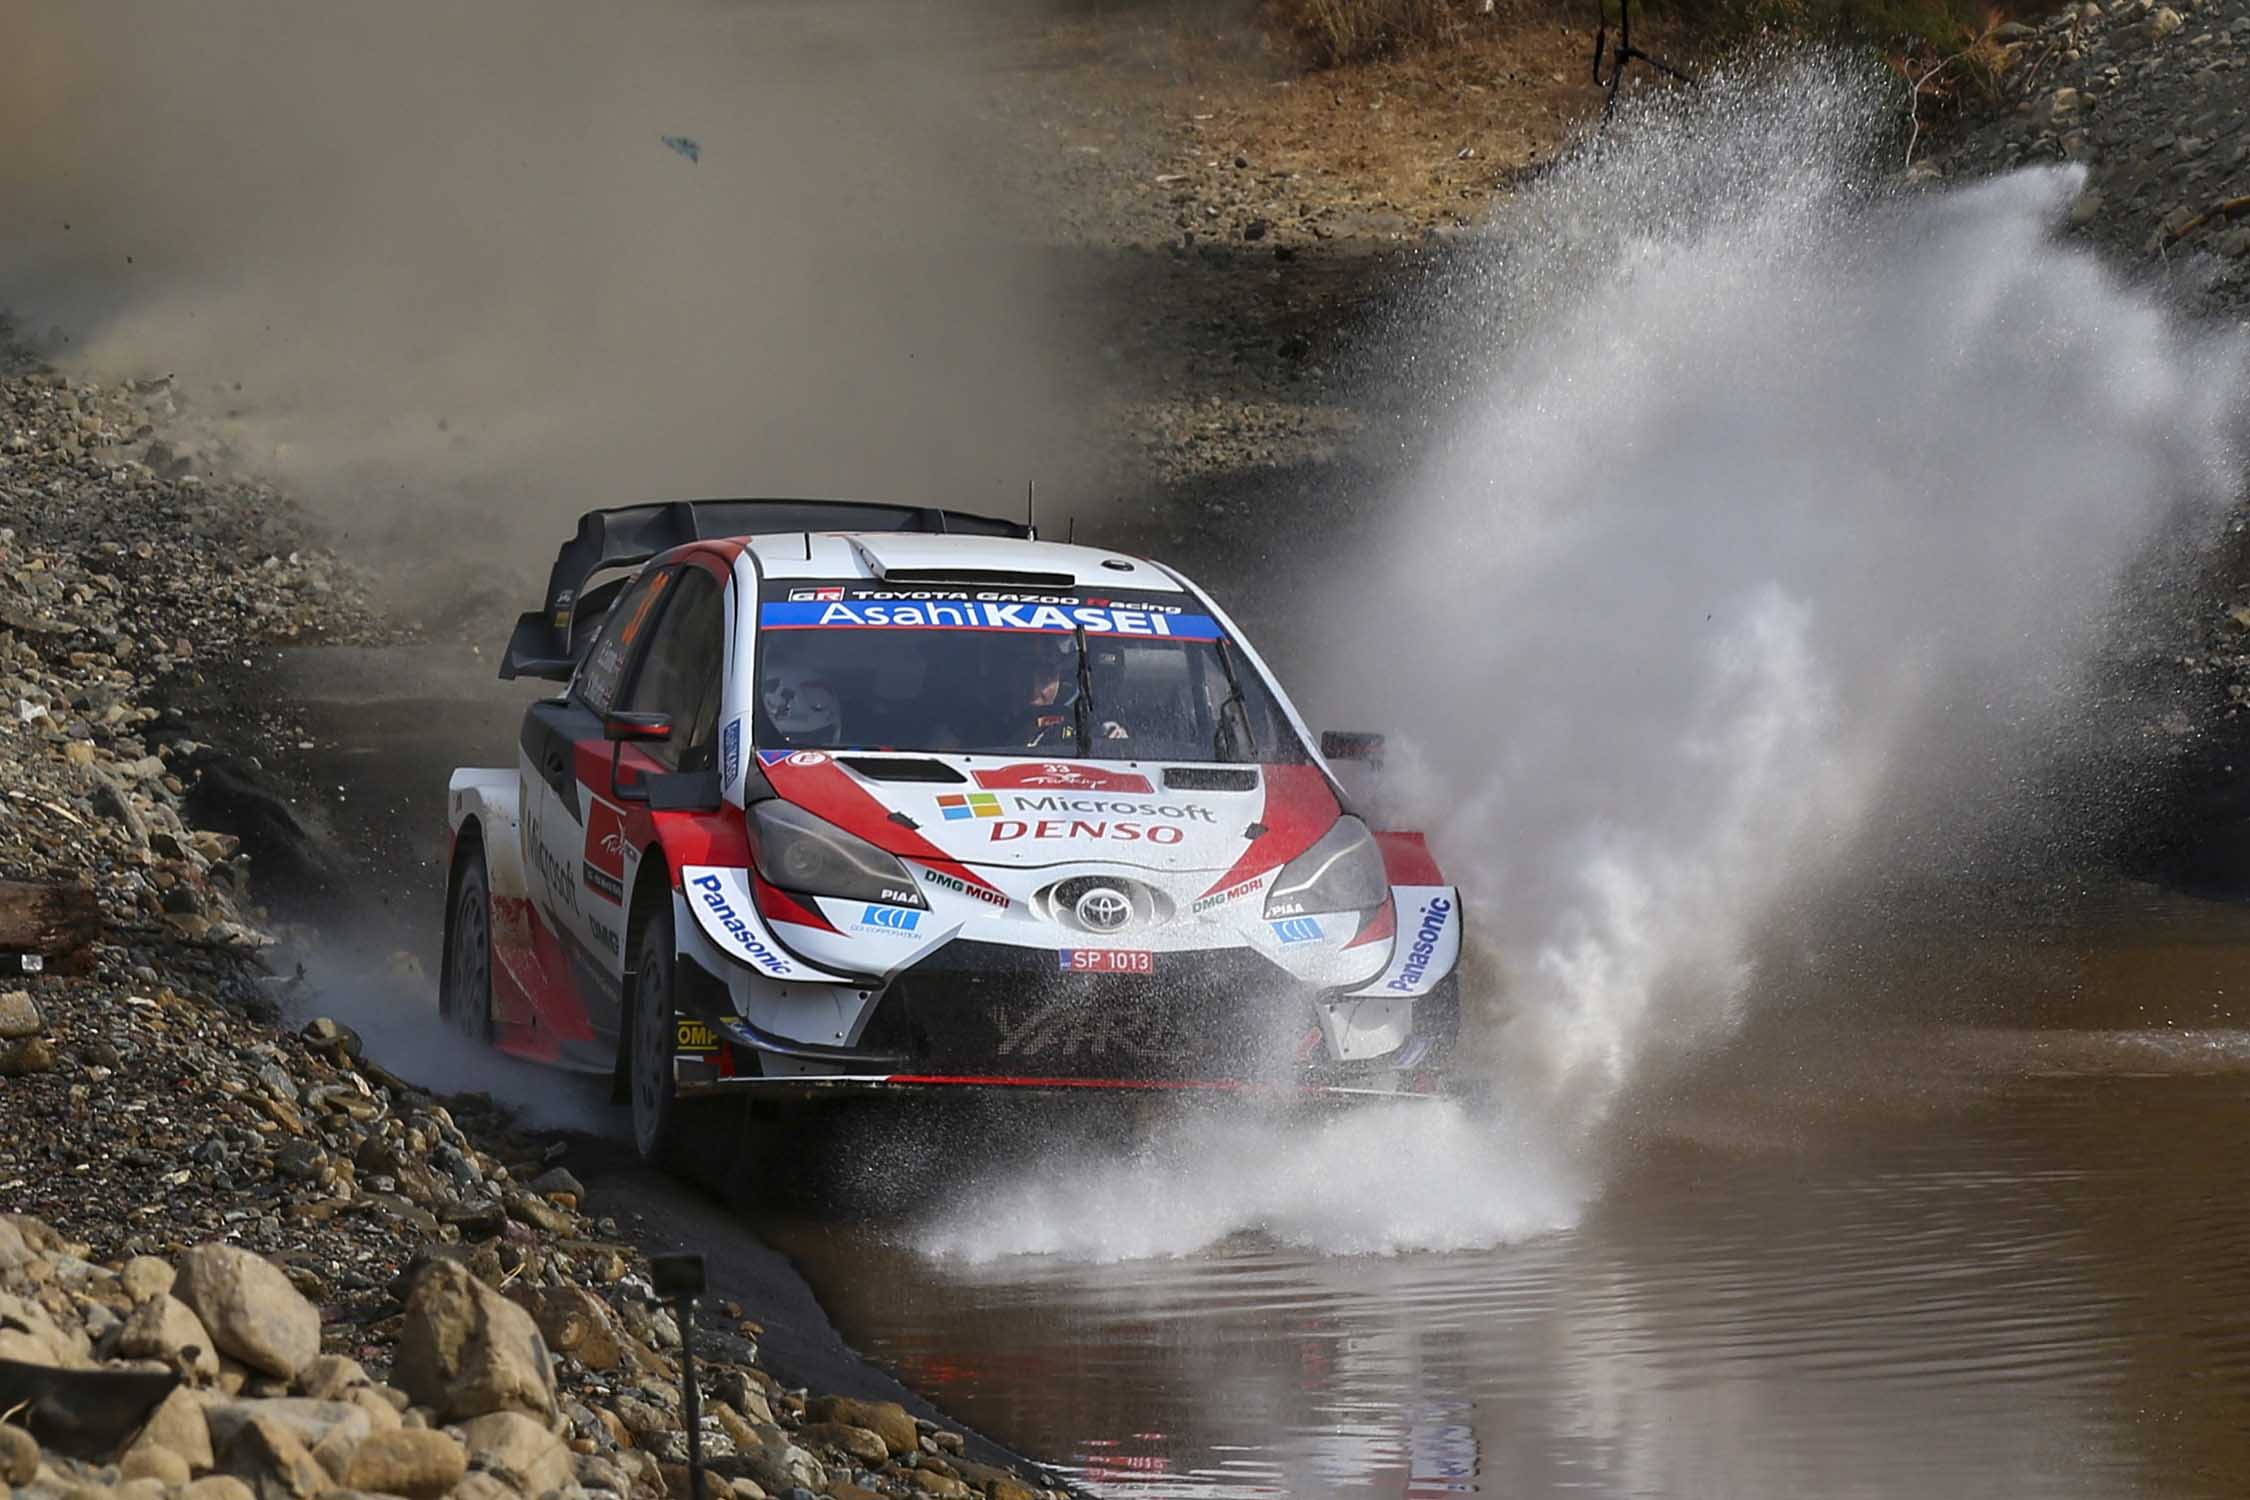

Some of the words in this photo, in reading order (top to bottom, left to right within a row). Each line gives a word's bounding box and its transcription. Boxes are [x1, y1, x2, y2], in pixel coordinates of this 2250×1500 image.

[852, 590, 968, 600] TOYOTA
[975, 591, 1080, 606] GAZOO
[1043, 763, 1070, 774] 33
[1013, 796, 1218, 825] Microsoft
[989, 819, 1185, 845] DENSO
[881, 888, 920, 905] PIAA
[924, 869, 964, 892] DMG
[965, 884, 1011, 909] MORI
[1191, 893, 1226, 914] DMG
[1226, 877, 1264, 901] MORI
[1271, 903, 1305, 917] PIAA
[692, 873, 792, 975] Panasonic
[1386, 897, 1452, 993] Panasonic
[1073, 951, 1101, 969] SP
[1107, 951, 1149, 970] 1013
